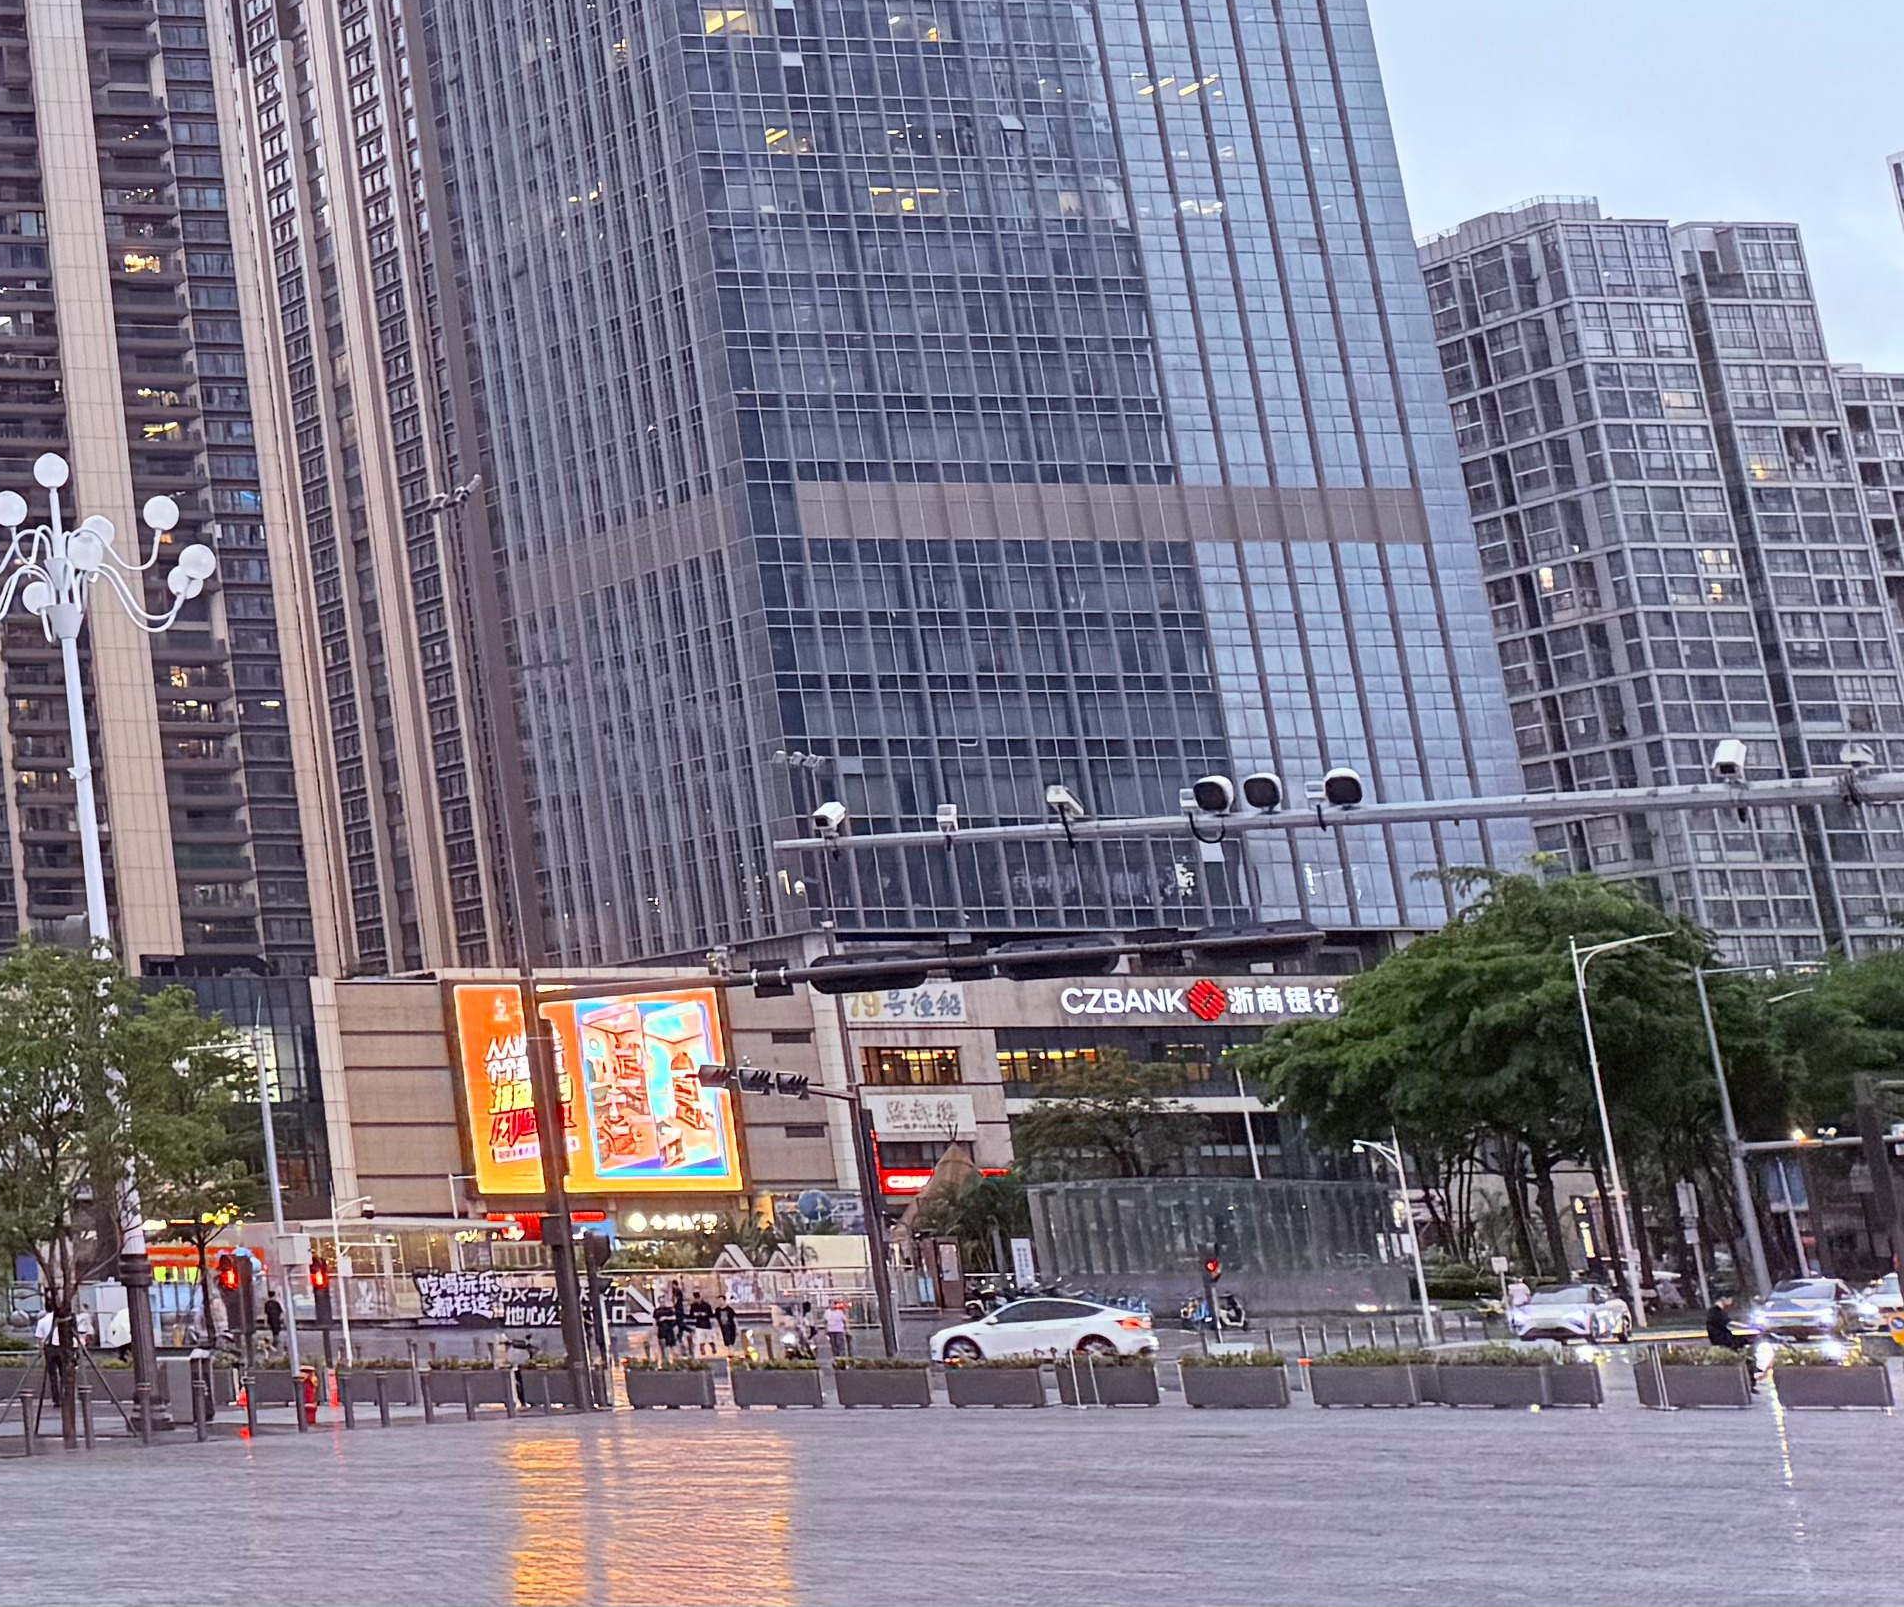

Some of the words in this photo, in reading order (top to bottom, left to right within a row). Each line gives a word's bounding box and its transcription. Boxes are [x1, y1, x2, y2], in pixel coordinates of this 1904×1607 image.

[1060, 987, 1188, 1015] CZBANK
[1226, 985, 1339, 1015] 浙商银行
[418, 1271, 500, 1296] 吃喝玩乐
[429, 1294, 493, 1319] 都在这
